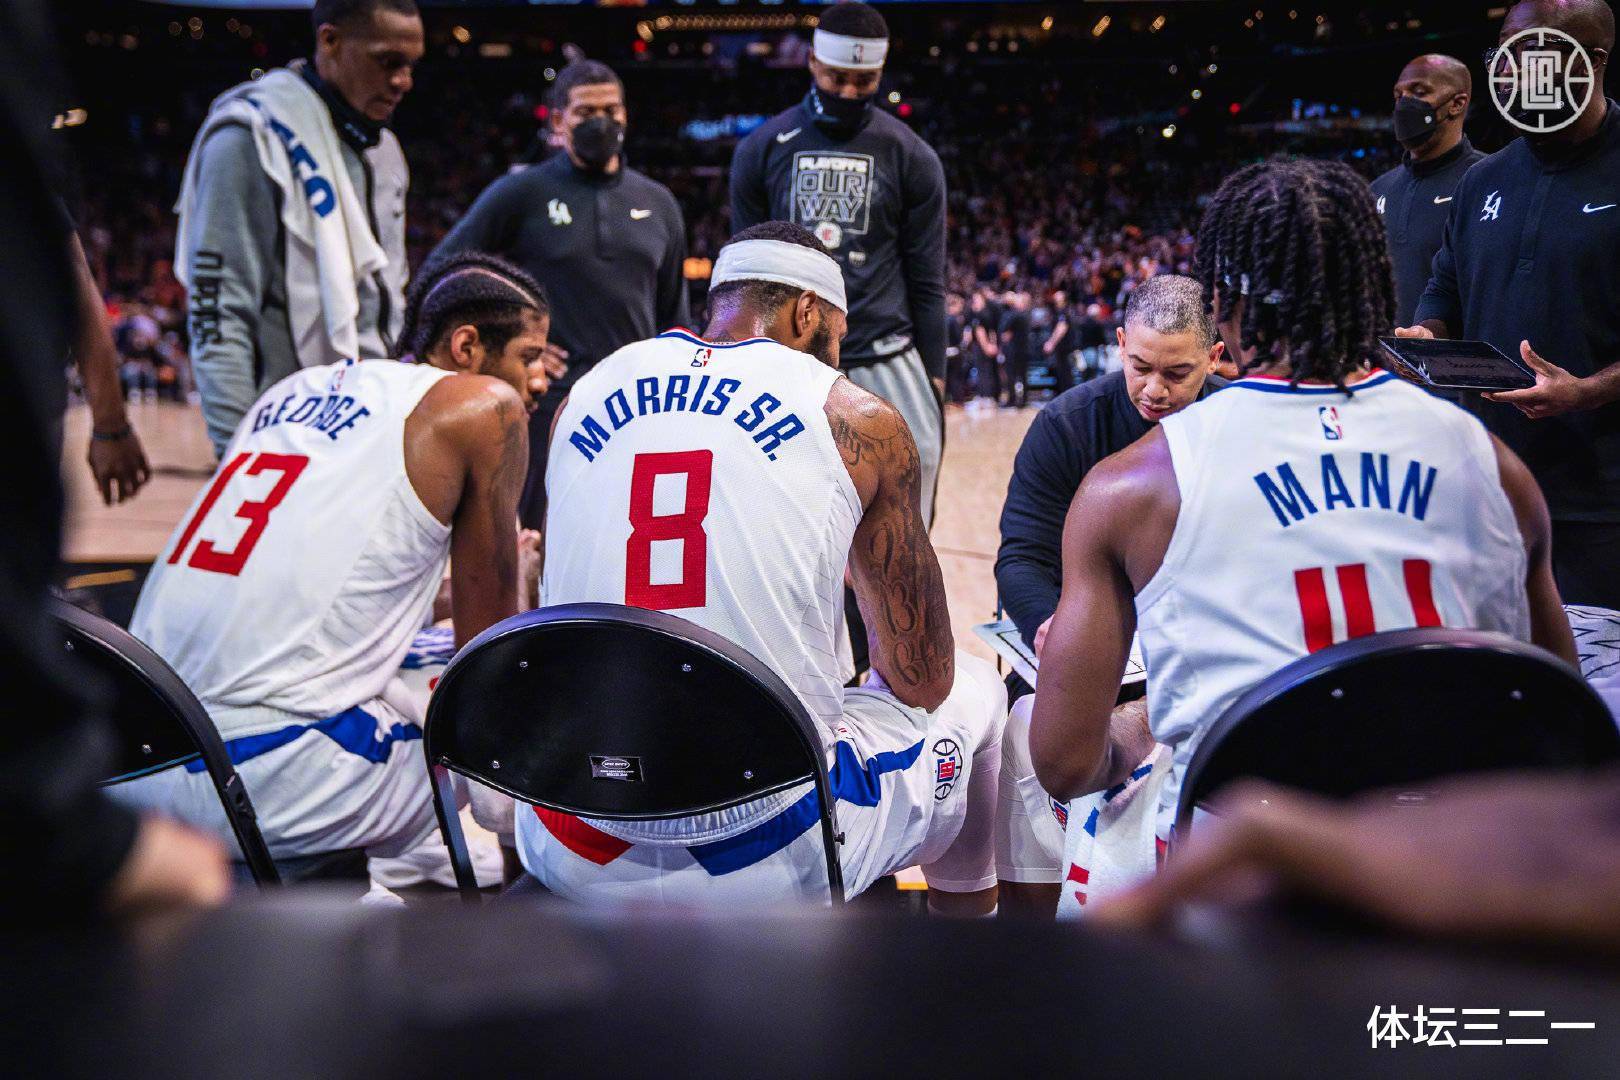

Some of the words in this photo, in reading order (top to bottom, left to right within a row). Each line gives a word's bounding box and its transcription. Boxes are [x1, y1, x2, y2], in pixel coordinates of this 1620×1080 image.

[796, 169, 867, 197] OUR
[796, 195, 865, 222] WAY
[251, 393, 371, 441] GEORGE
[568, 374, 742, 463] MORRIS
[733, 392, 806, 462] SR.
[167, 452, 310, 577] 13
[1253, 451, 1438, 528] MANN
[625, 448, 714, 611] 8
